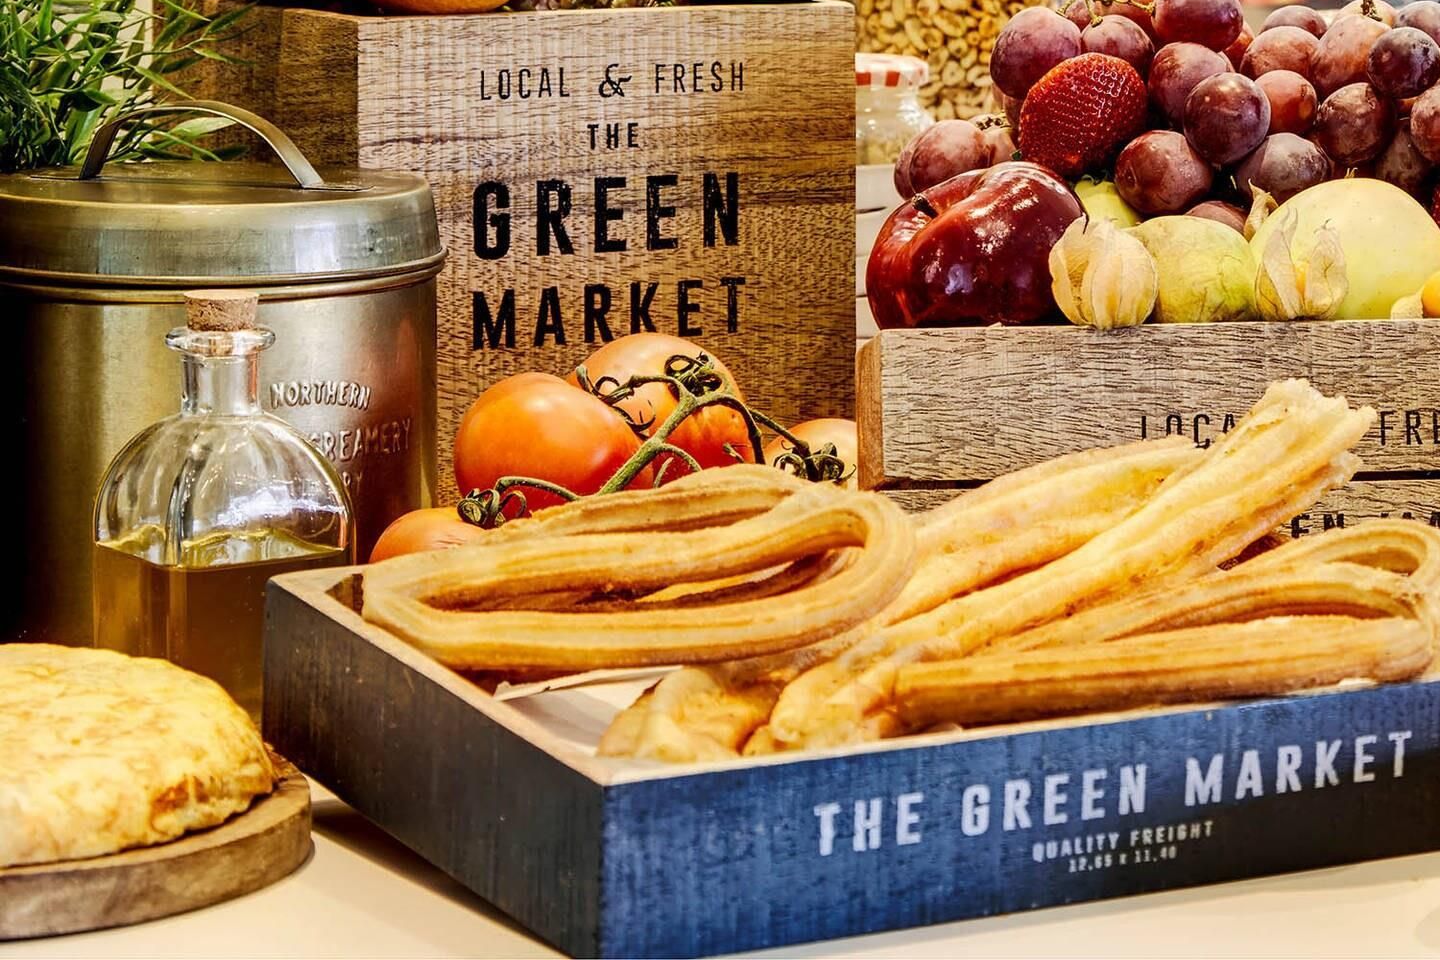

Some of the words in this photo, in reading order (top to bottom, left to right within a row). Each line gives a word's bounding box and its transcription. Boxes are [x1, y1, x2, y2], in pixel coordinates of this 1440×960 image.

[480, 67, 570, 100] LOCAL
[598, 63, 632, 97] &
[655, 61, 744, 93] FRESH
[587, 122, 639, 150] THE
[472, 171, 739, 260] GREEN
[472, 276, 746, 351] MARKET
[270, 381, 372, 410] NORTHERN
[1141, 413, 1236, 449] LOCA
[813, 790, 924, 857] THE
[961, 763, 1148, 837] GREEN
[1184, 730, 1412, 807] MARKET
[1032, 832, 1119, 863] QUALITY
[1130, 820, 1214, 847] FREIGHT
